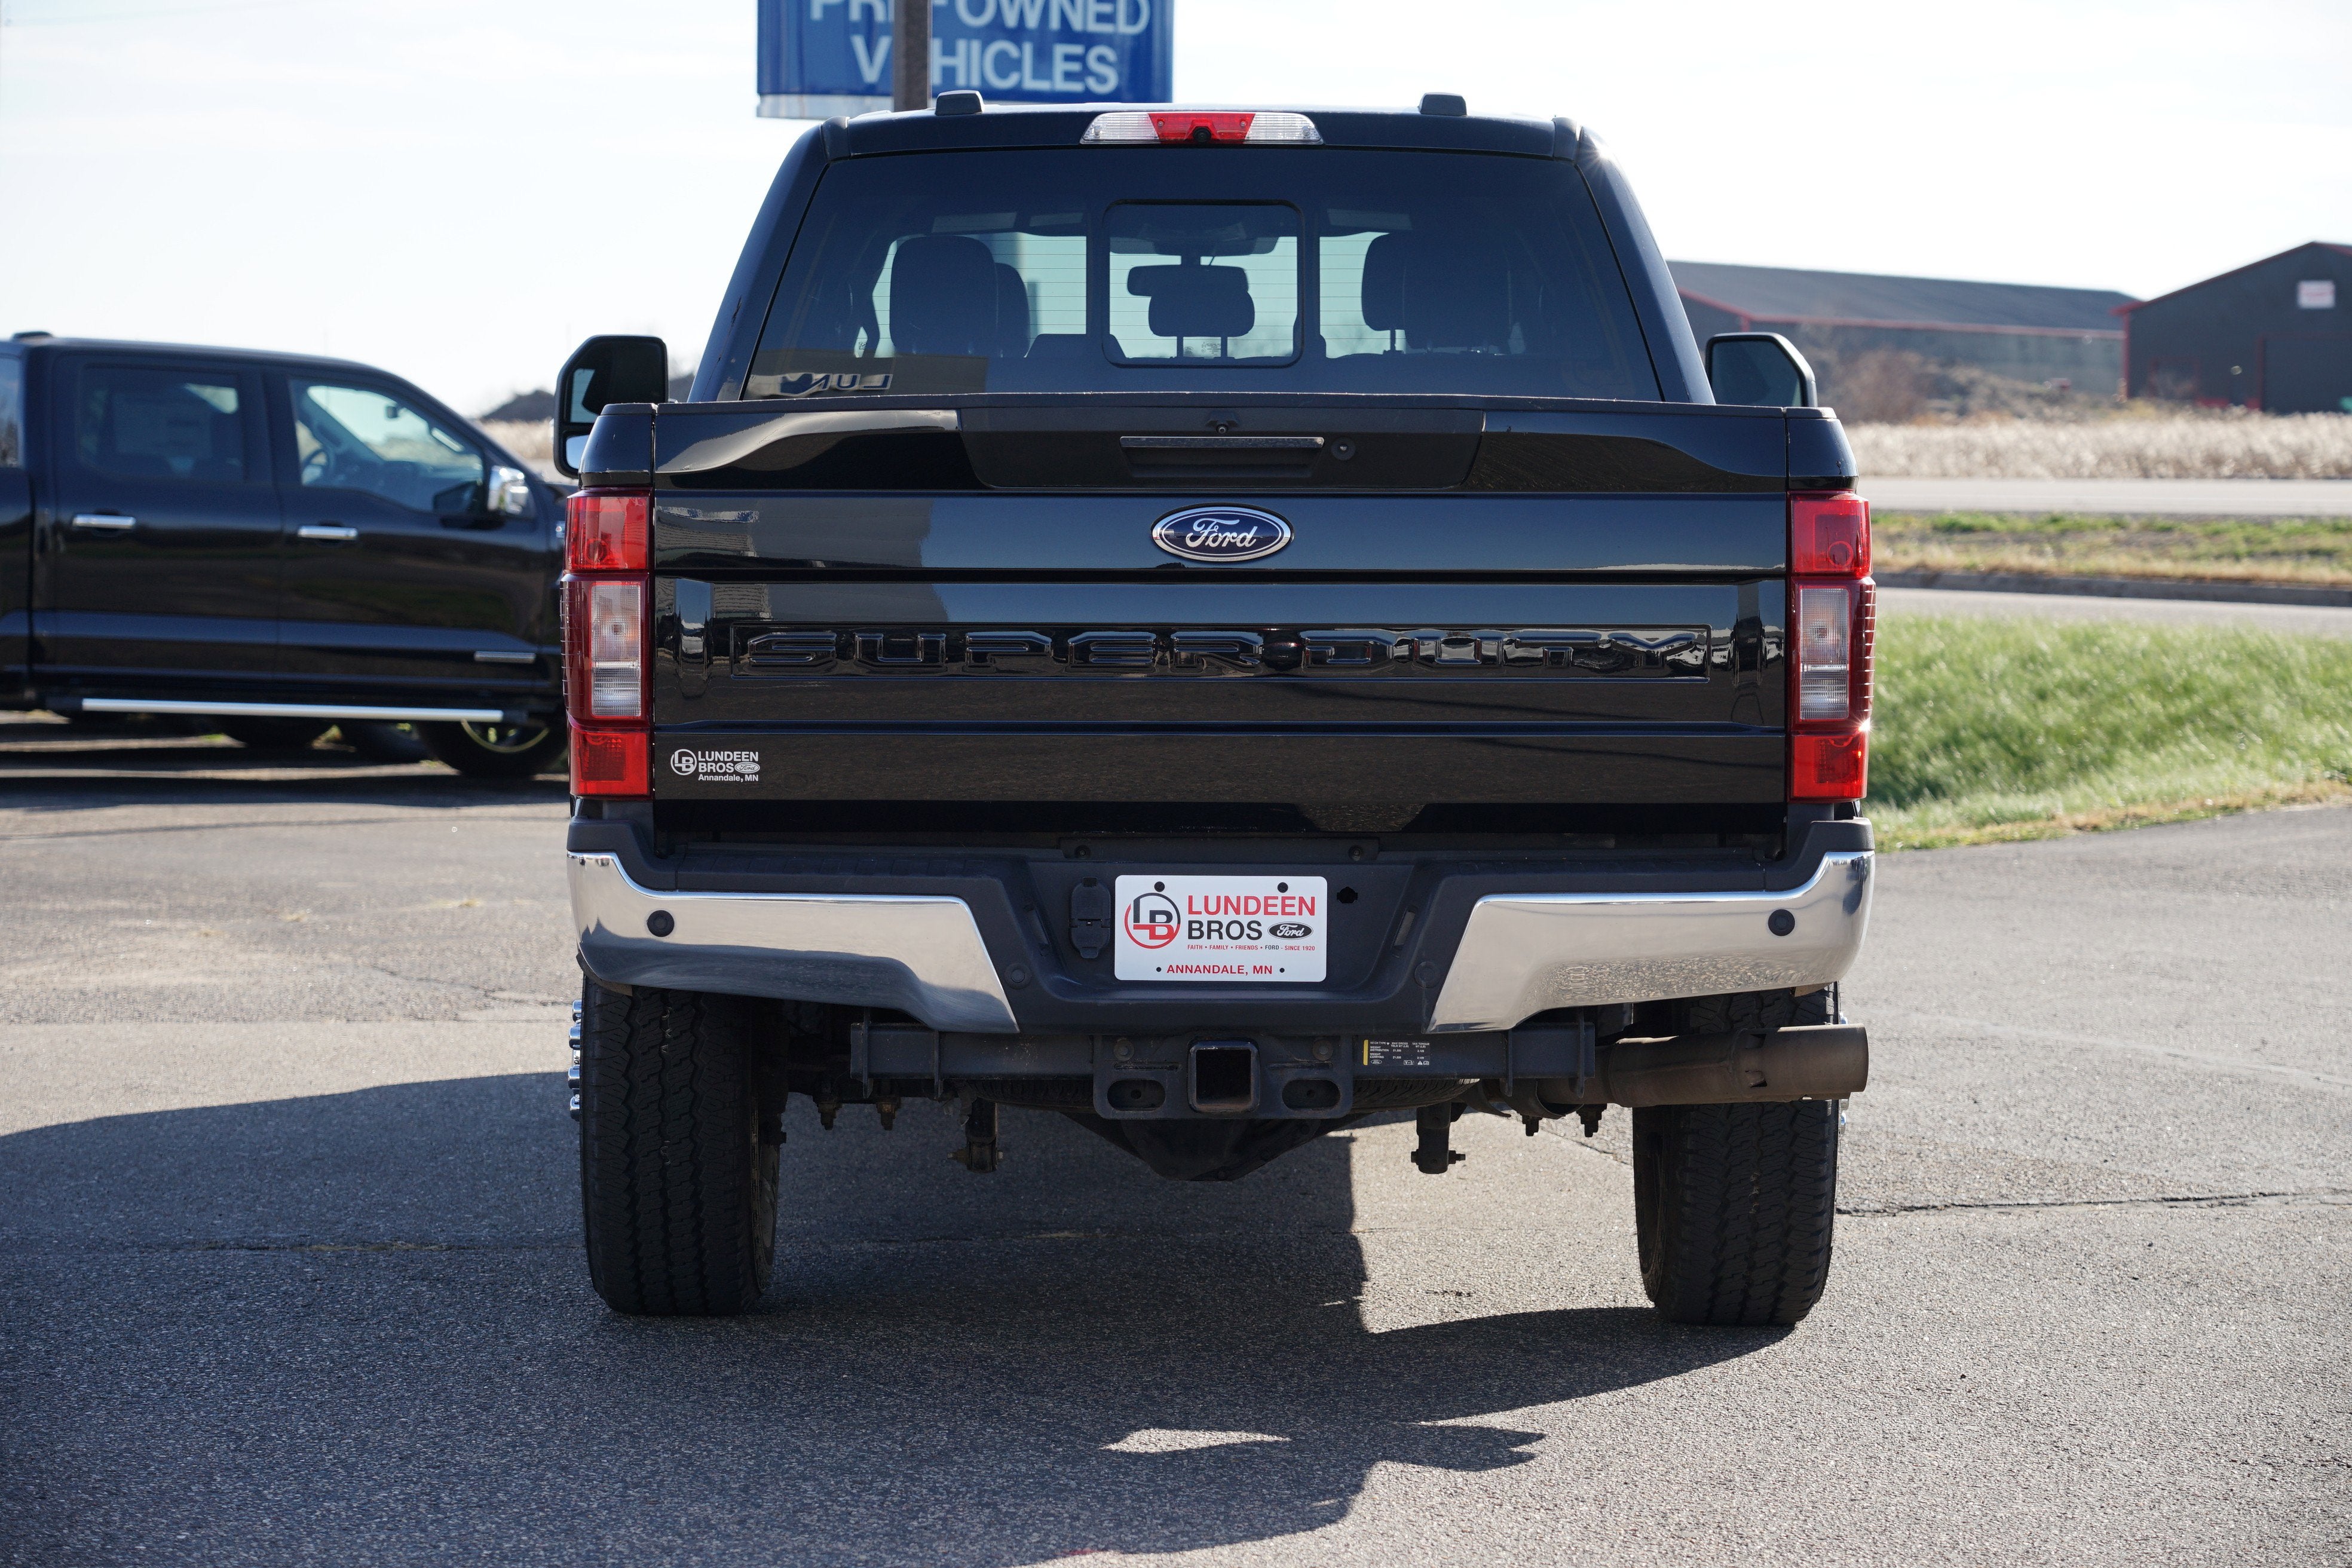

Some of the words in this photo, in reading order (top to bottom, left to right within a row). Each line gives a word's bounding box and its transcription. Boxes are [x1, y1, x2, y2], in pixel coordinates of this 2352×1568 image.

[810, 0, 1150, 35] -OWNED
[850, 34, 1119, 94] VHICLES
[1186, 517, 1258, 547] Ford
[746, 630, 1262, 673] SUPER
[1300, 629, 1697, 672] DUTY
[698, 751, 759, 762] LUNDEEN
[698, 762, 734, 773] BROS
[698, 774, 743, 783] Annandale,
[1187, 895, 1315, 916] LUNDEEN
[1187, 920, 1263, 941] BROS
[1276, 923, 1304, 938] Ford
[1166, 964, 1248, 976] ANNANDALE,
[1252, 964, 1273, 975] MN
